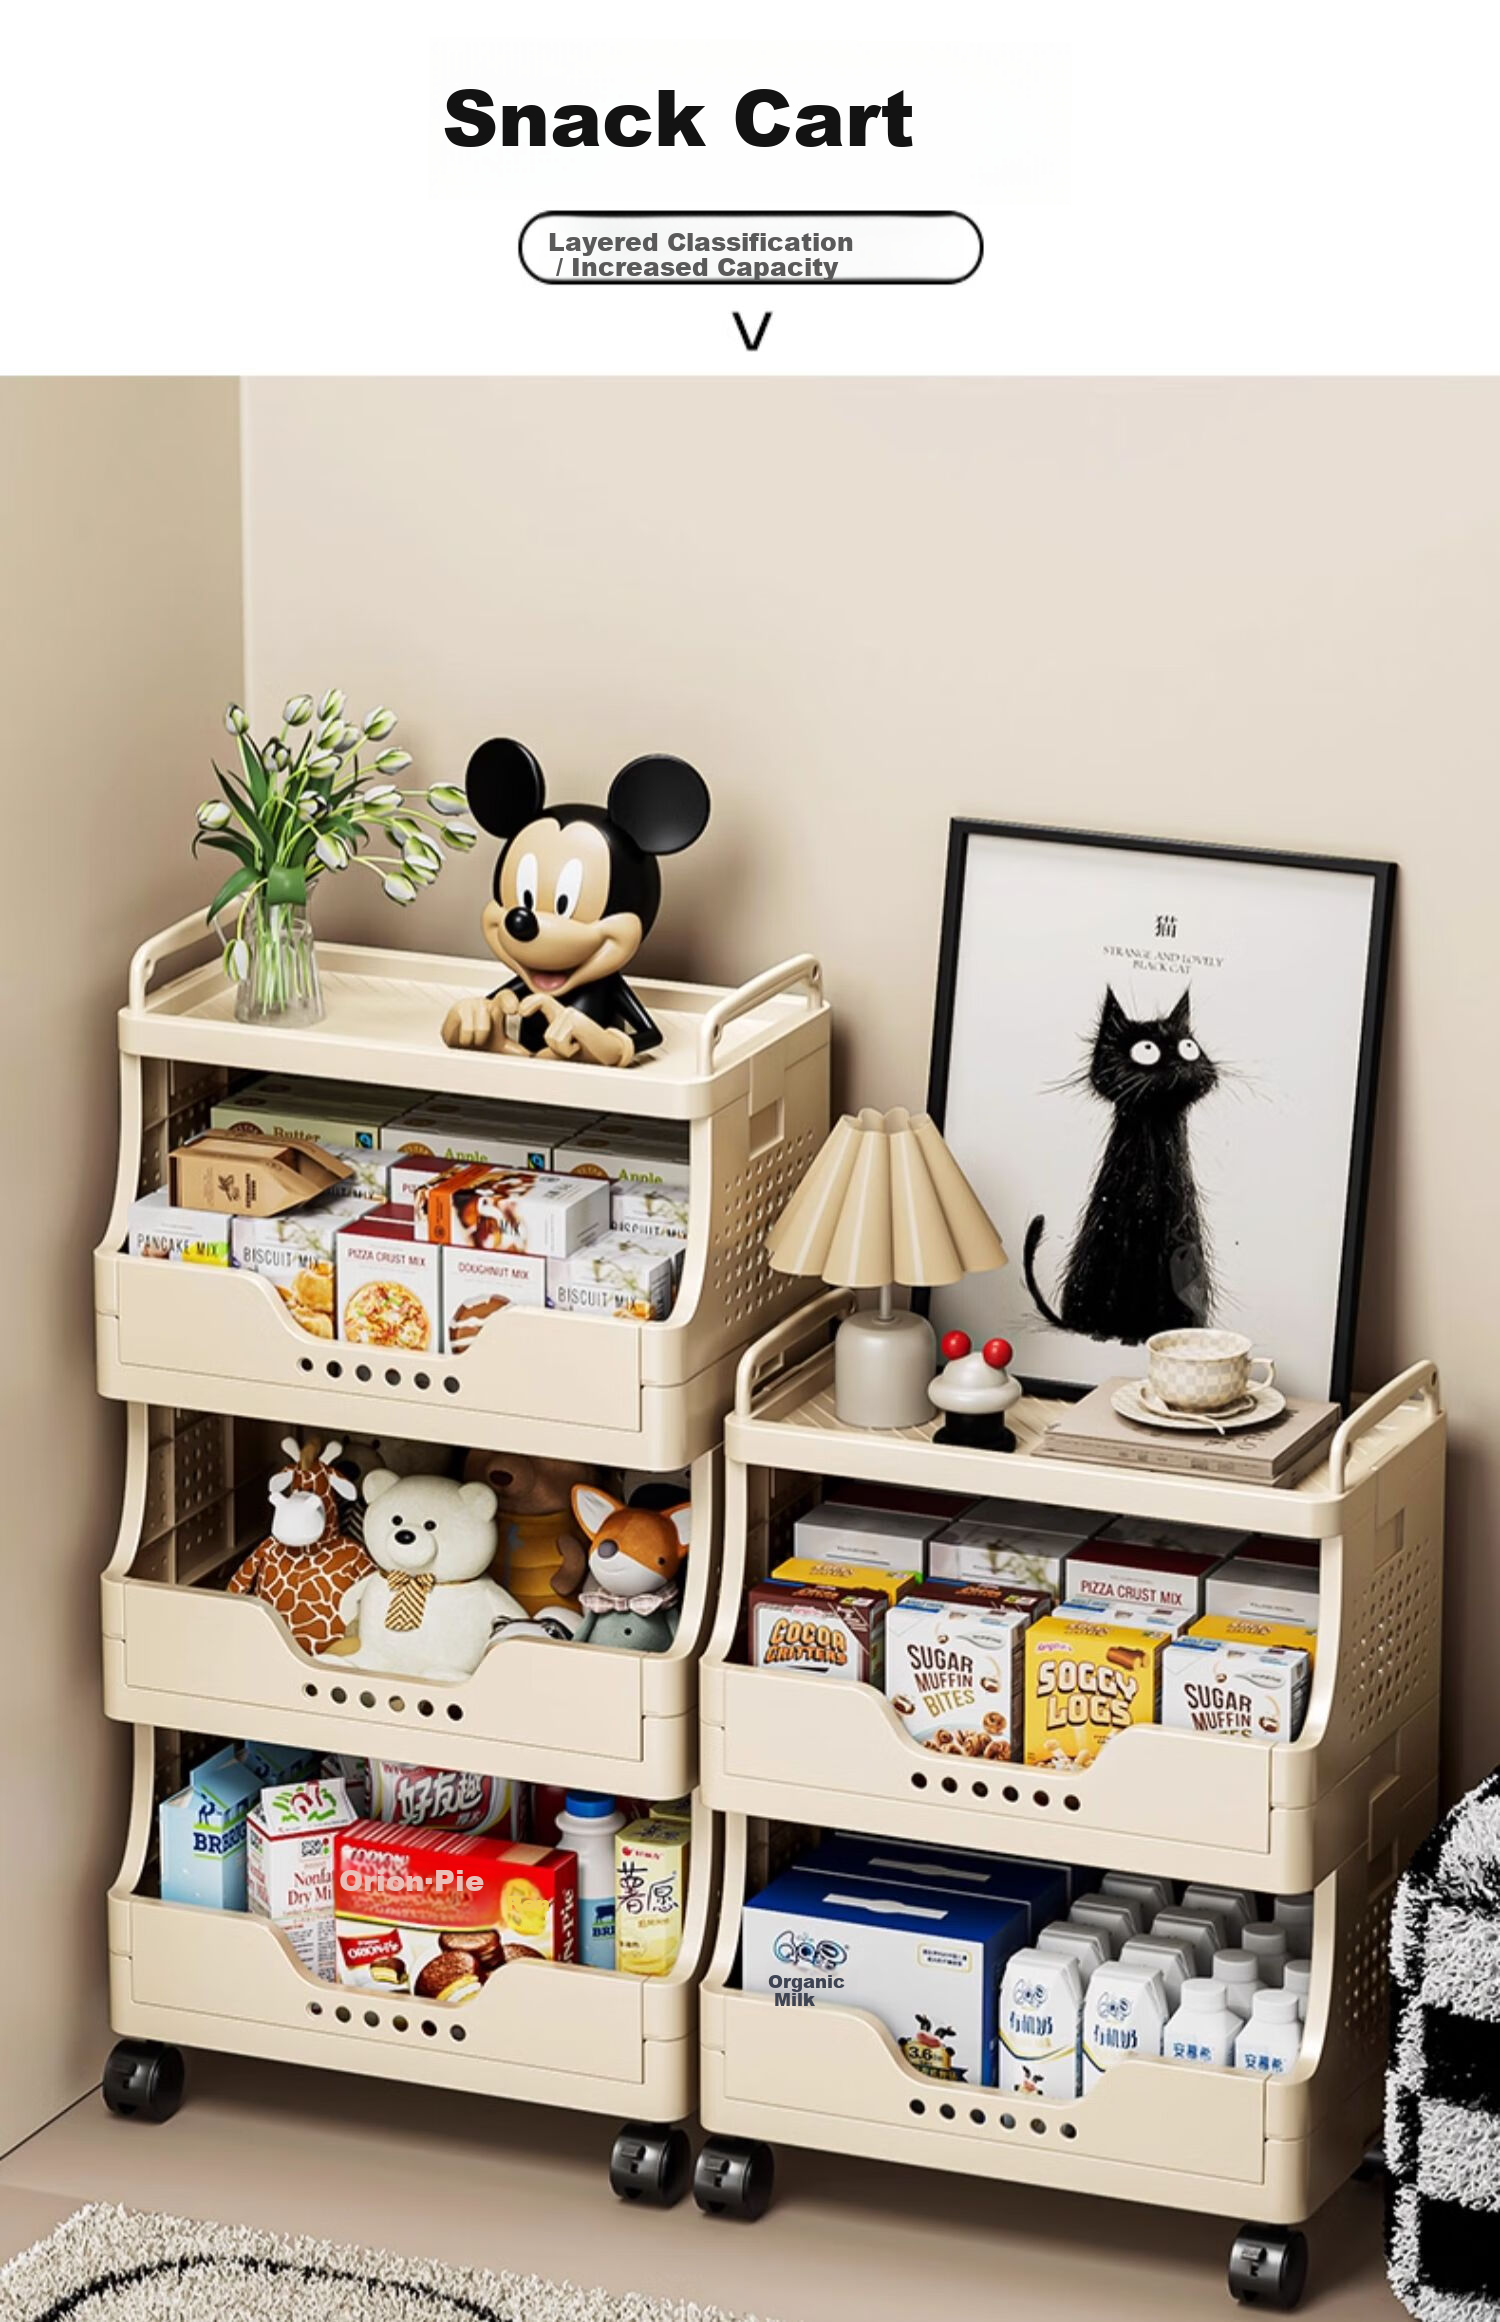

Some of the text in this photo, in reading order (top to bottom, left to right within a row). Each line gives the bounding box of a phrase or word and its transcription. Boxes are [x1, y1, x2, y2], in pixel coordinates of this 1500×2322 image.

[1103, 945, 1151, 960] STRANGE
[1153, 952, 1181, 963] AND
[1132, 959, 1192, 974] BLACK CAT
[137, 1233, 219, 1257] PANCAKE MIX
[243, 1246, 293, 1267] BISCUIT
[347, 1247, 426, 1267] PIZZA CRUST MIX
[458, 1261, 529, 1280] DOUGHNUT MIX
[557, 1286, 608, 1308] BISCUIT
[1081, 1580, 1183, 1606] PIZZA CRUST MIX
[769, 1617, 848, 1654] COCOA
[763, 1646, 848, 1667] CRITTERS
[907, 1643, 974, 1674] SUGAR
[914, 1672, 974, 1694] MUFFIN
[1036, 1660, 1139, 1704] SOGGY
[922, 1689, 976, 1718] BITES
[1184, 1683, 1252, 1714] SUGAR
[1046, 1693, 1133, 1731] LOGS
[1191, 1712, 1252, 1731] MUFFIN
[294, 1868, 335, 1886] Nonfa
[288, 1891, 311, 1907] Dry
[908, 2046, 933, 2061] 3.6
